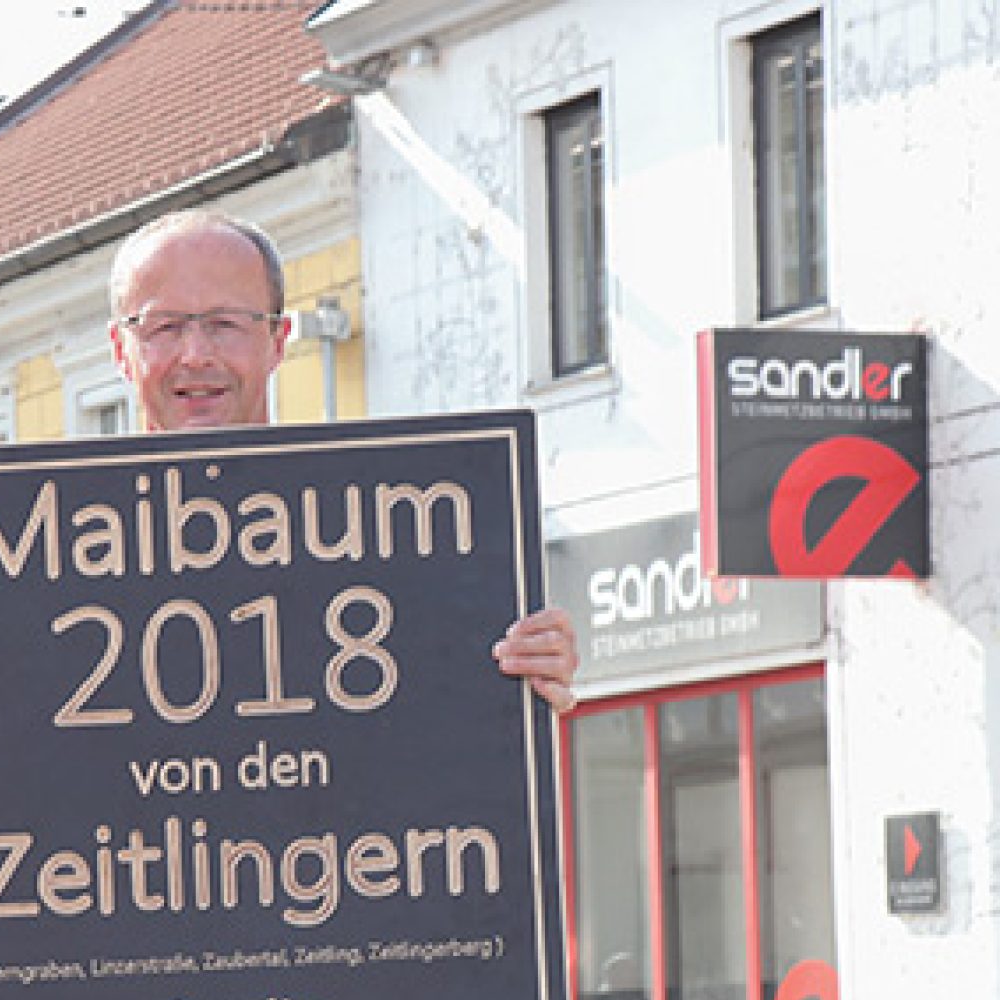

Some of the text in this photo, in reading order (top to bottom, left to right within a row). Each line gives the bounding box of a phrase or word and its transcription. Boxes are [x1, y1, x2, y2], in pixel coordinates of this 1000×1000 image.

[728, 347, 913, 402] sandler
[51, 586, 397, 727] 2018
[129, 741, 327, 795] von den
